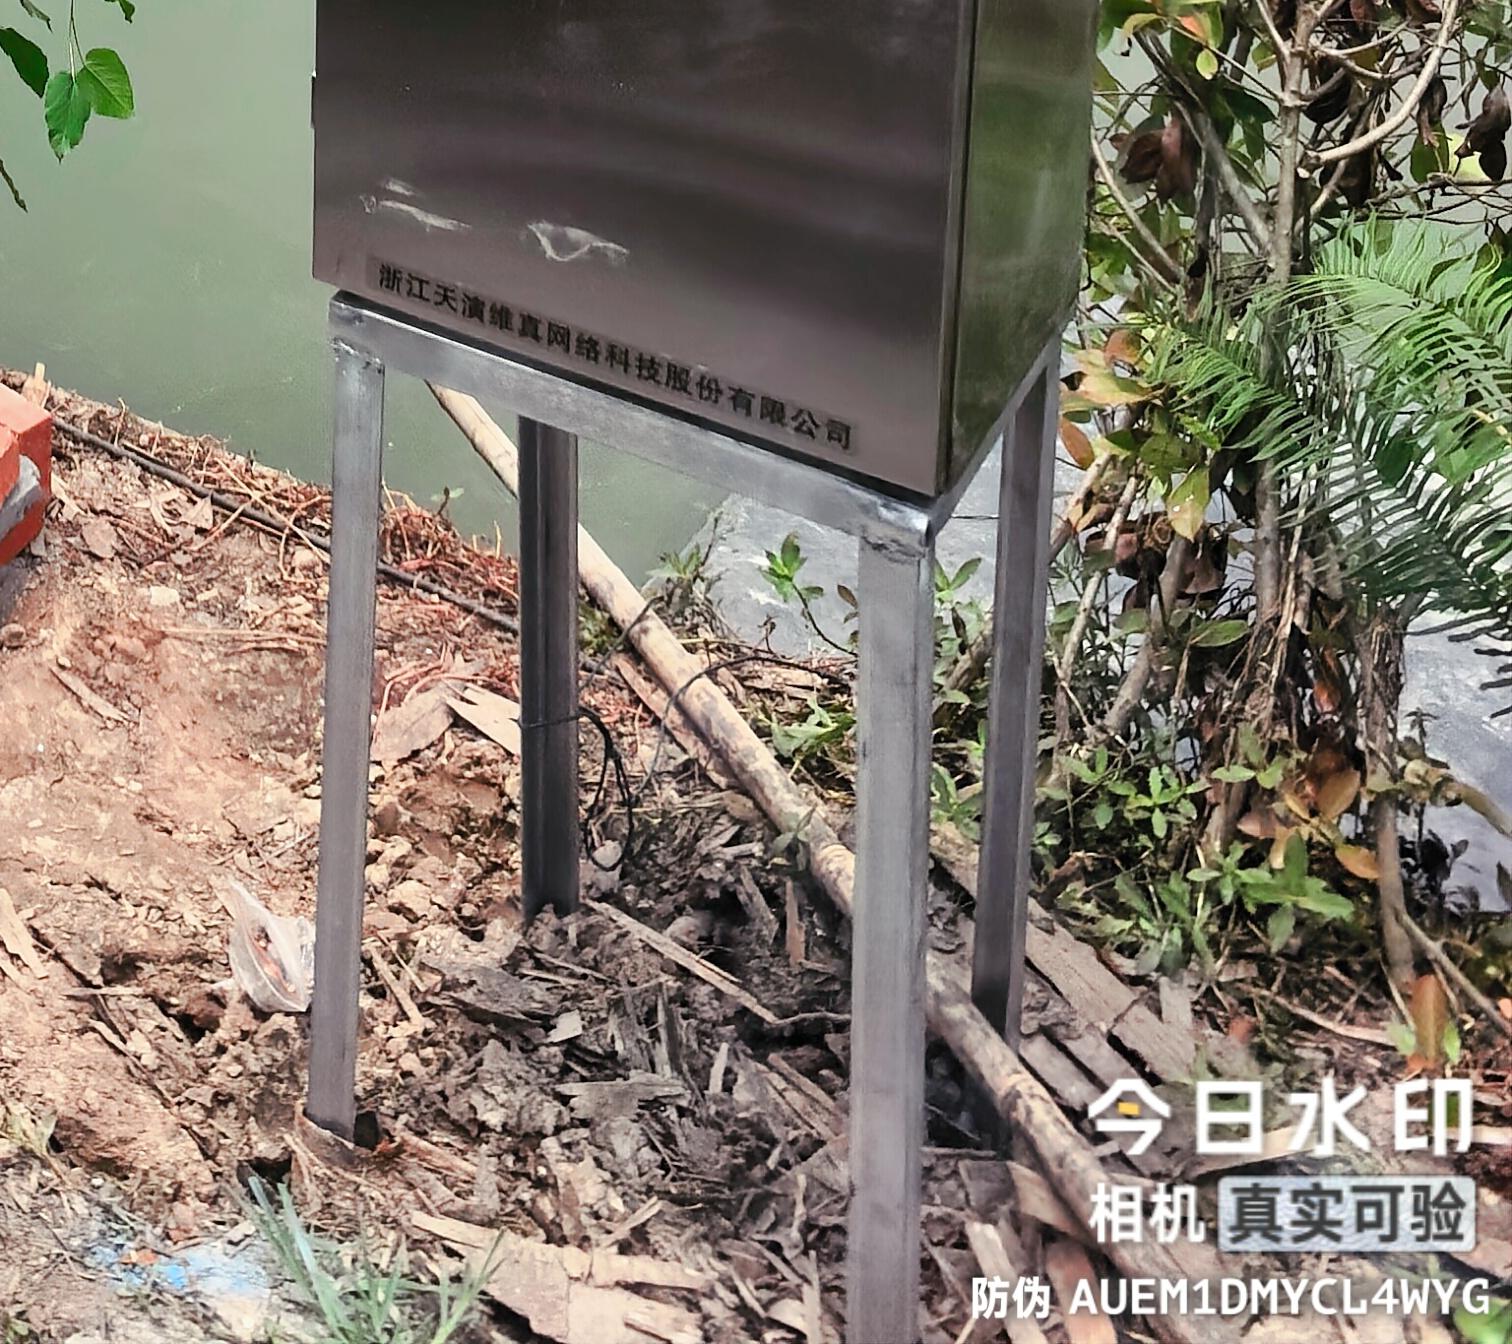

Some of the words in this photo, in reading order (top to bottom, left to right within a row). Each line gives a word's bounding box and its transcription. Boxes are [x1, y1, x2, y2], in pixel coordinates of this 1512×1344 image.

[378, 262, 852, 451] 浙江天演维真网络科技股份有限公司
